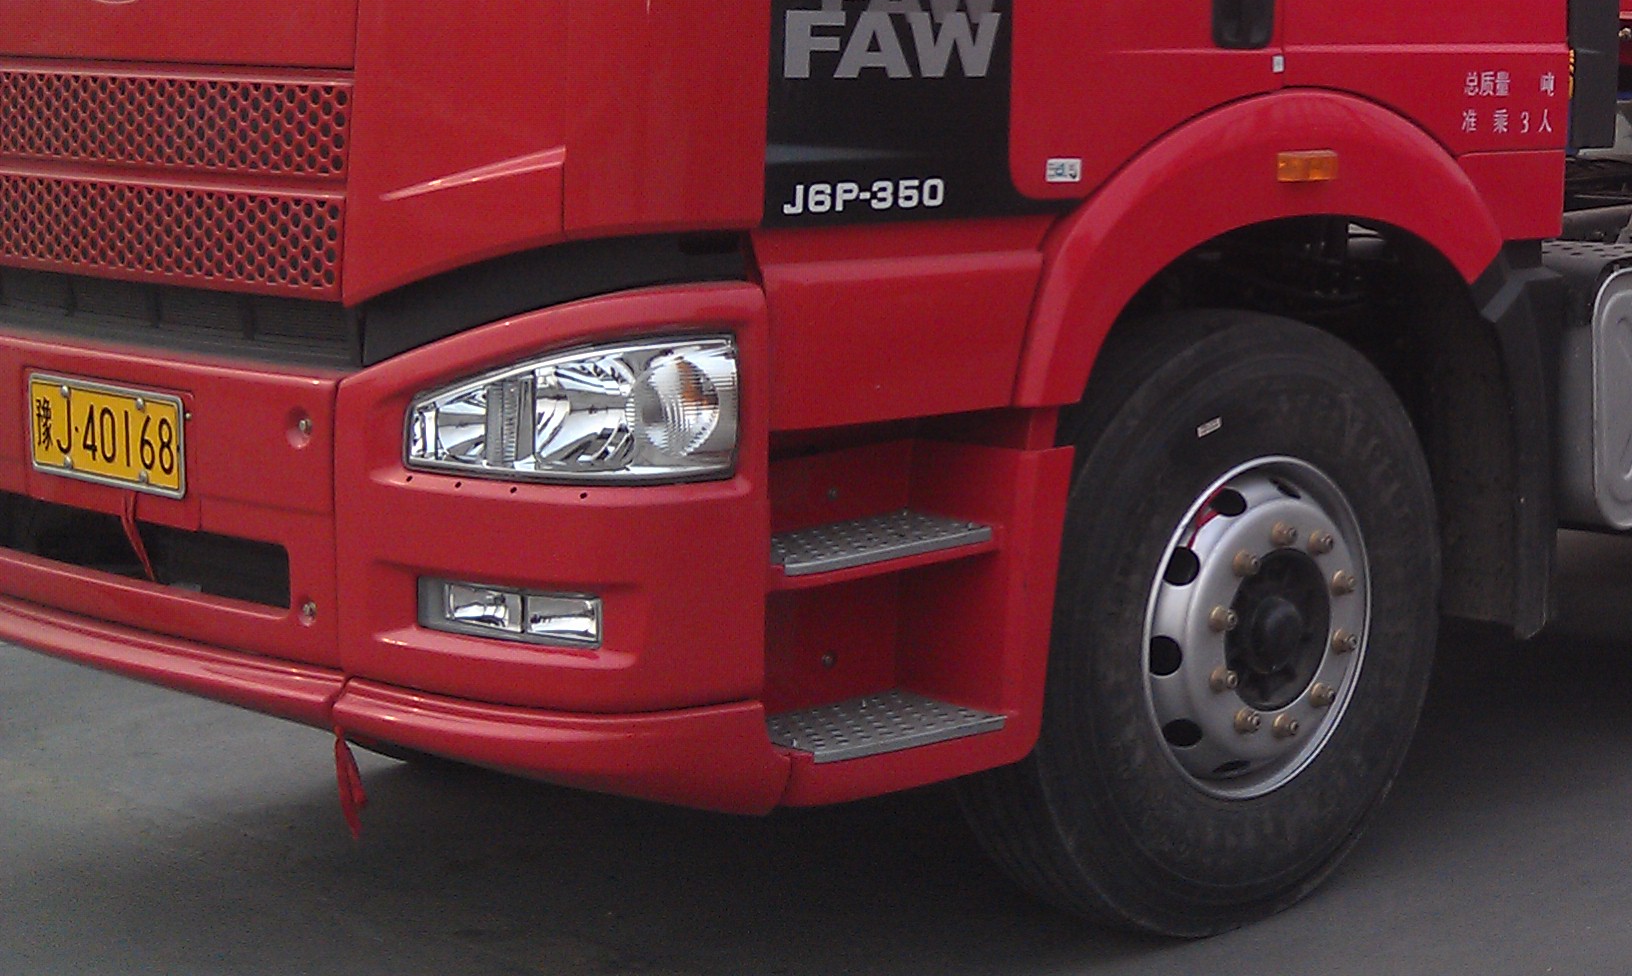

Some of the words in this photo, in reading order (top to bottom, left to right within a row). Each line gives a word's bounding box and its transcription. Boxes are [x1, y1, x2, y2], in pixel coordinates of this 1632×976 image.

[784, 9, 1001, 79] FAW
[1464, 71, 1511, 97] 总质量
[783, 178, 945, 215] J6P-350
